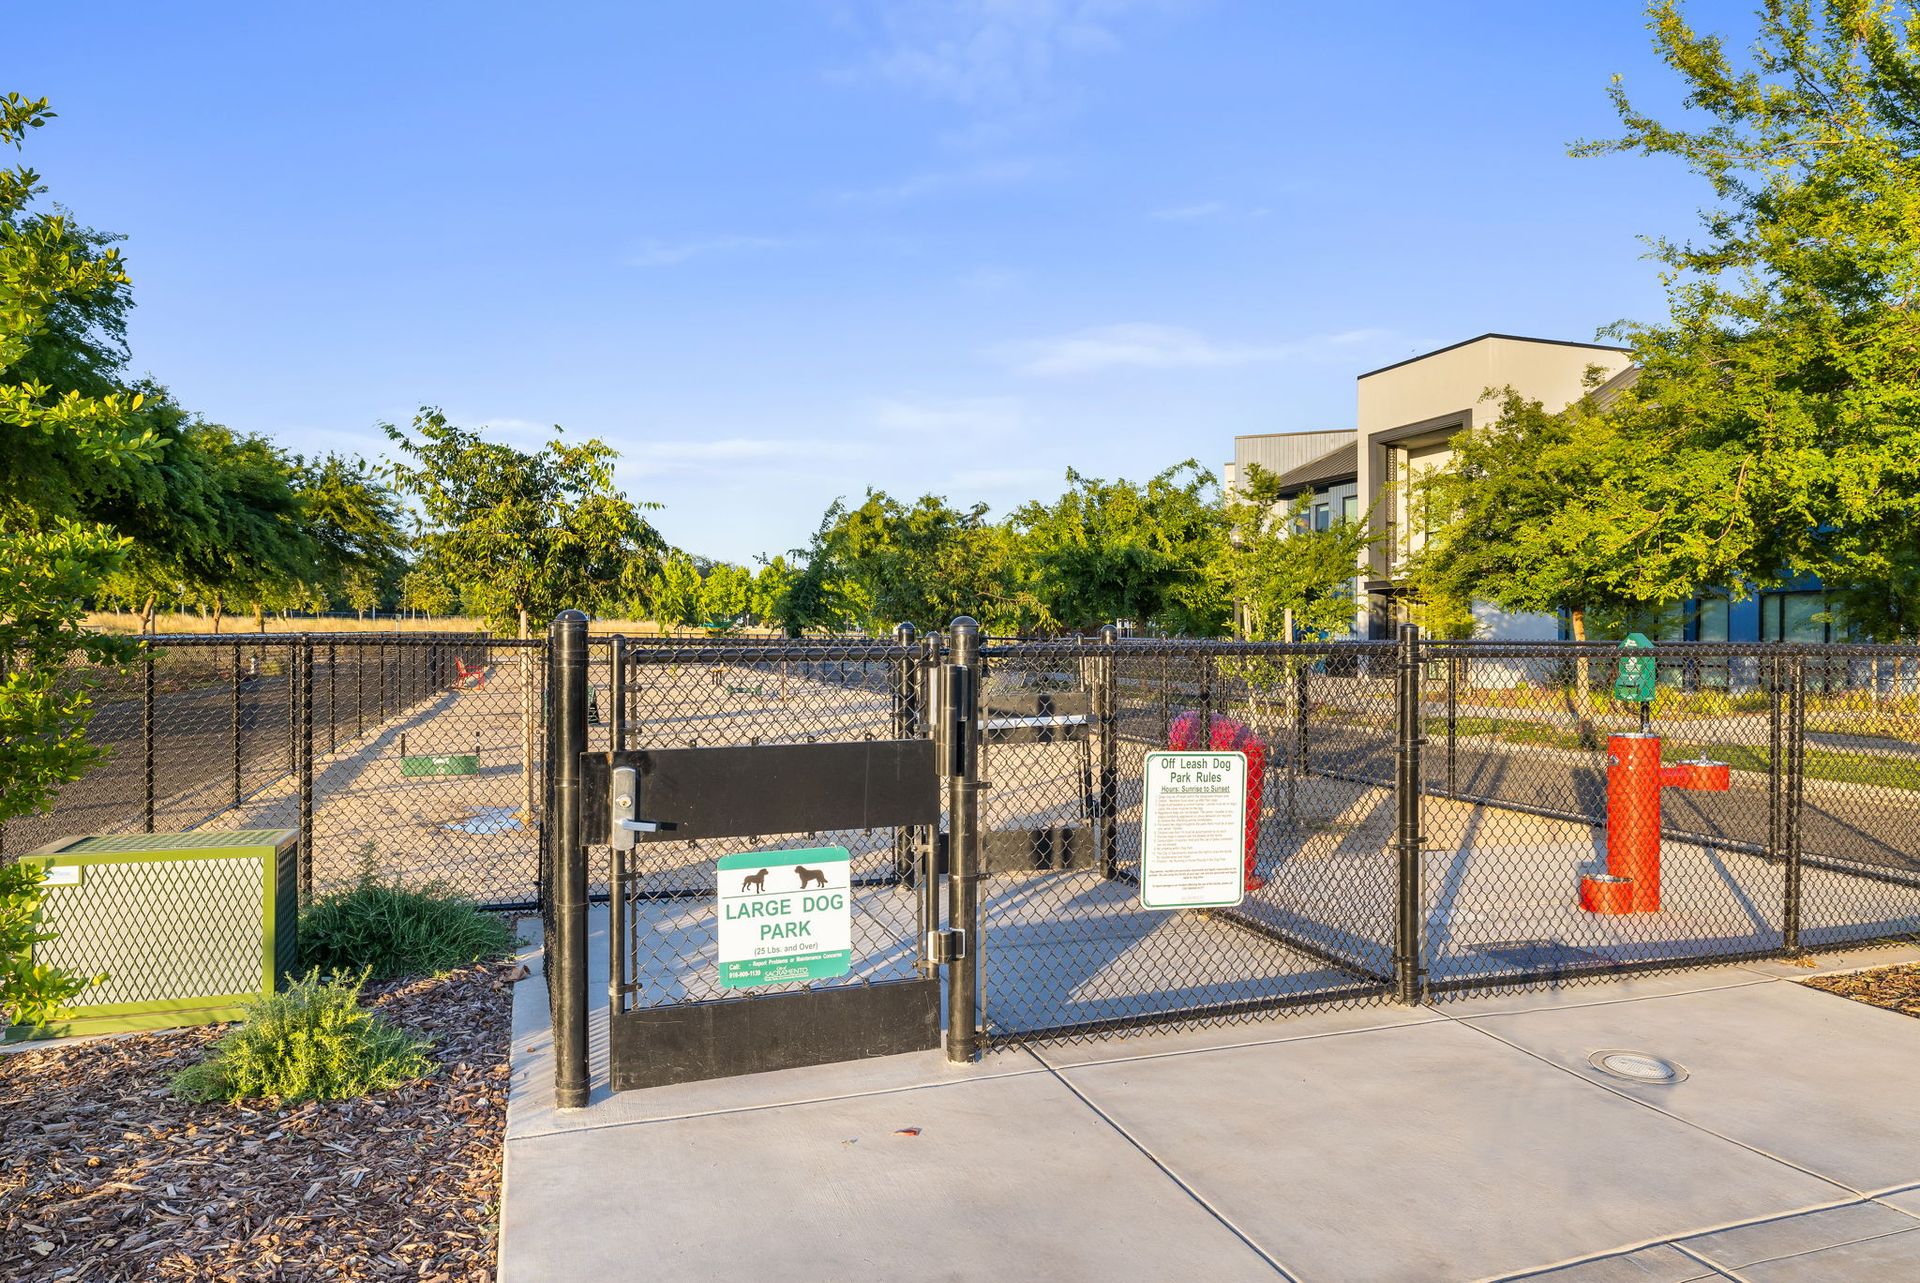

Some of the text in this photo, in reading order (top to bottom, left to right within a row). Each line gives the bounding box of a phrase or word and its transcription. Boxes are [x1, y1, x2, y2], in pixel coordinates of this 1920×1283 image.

[1161, 758, 1231, 771] Off Leash Dog
[1170, 772, 1222, 783] Park Rules
[726, 894, 843, 920] LARGE DOG
[760, 920, 811, 940] PARK
[754, 942, 819, 957] (25 Lbs. and Over)
[728, 963, 741, 971] Call:
[752, 960, 767, 968] Report
[768, 957, 788, 965] Problems
[764, 967, 808, 977] SACRAMENTO
